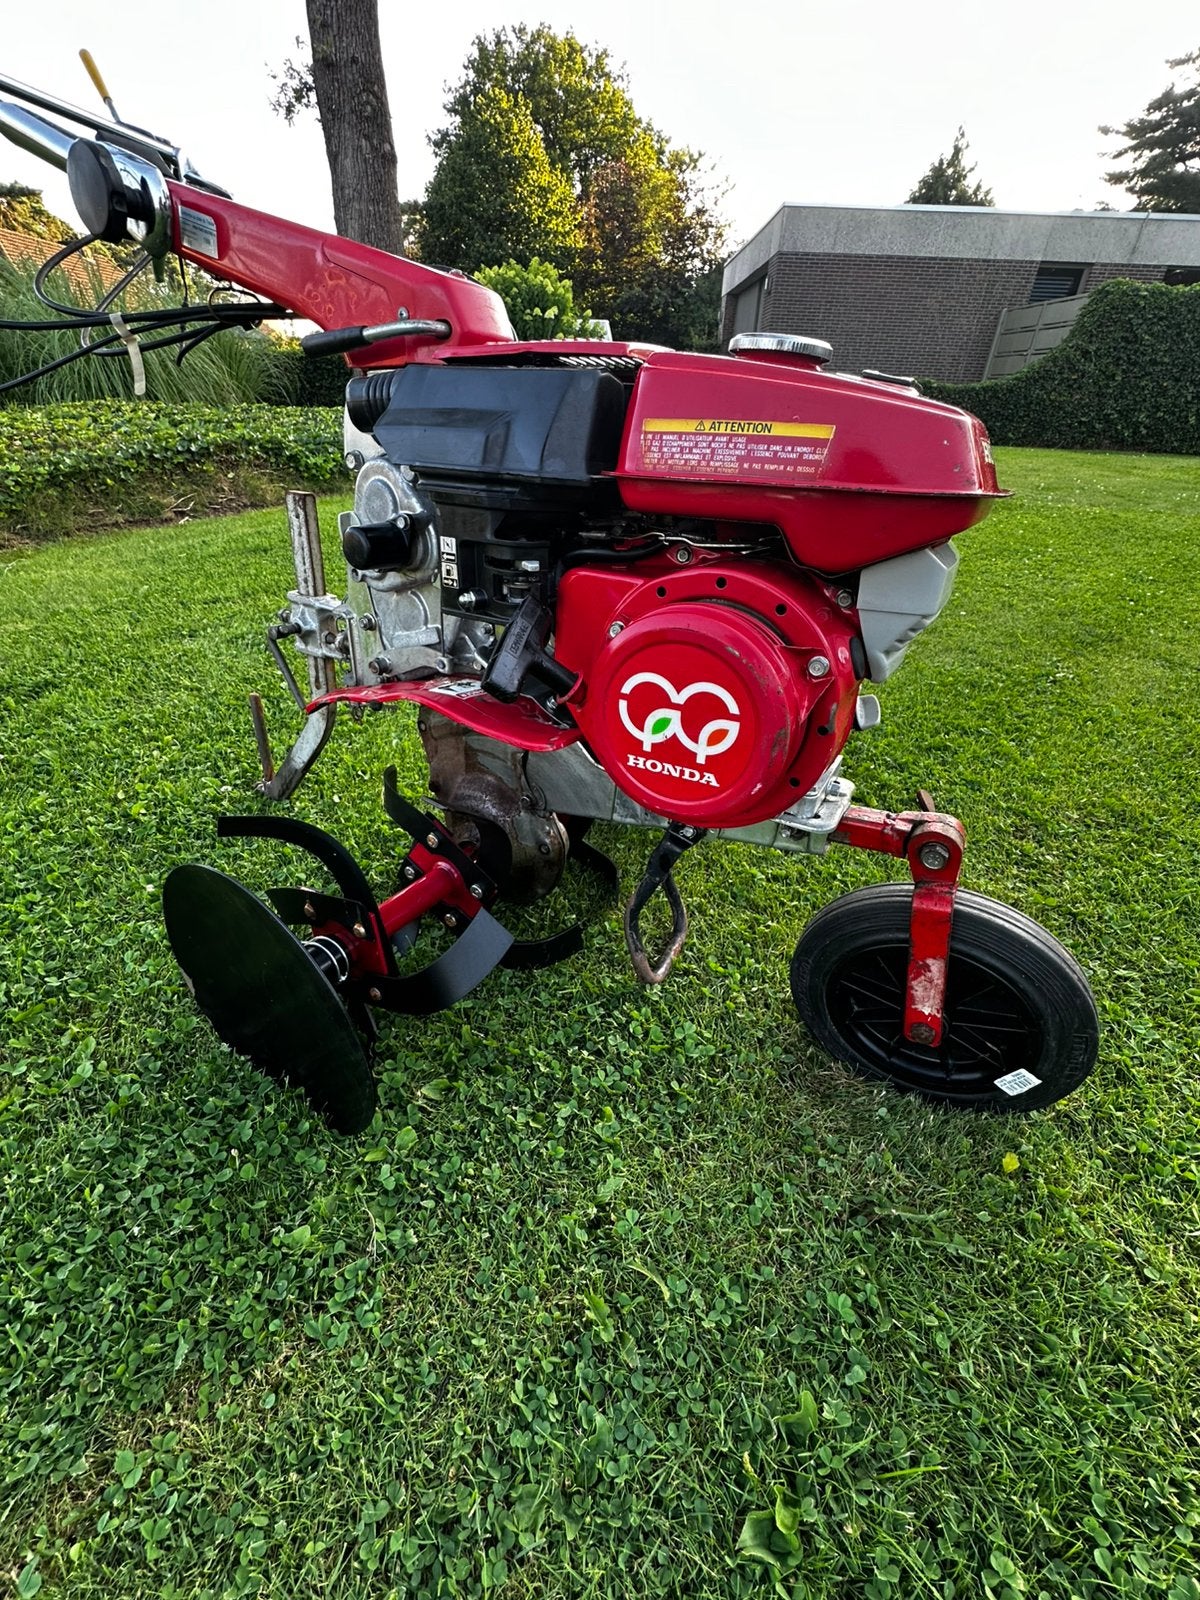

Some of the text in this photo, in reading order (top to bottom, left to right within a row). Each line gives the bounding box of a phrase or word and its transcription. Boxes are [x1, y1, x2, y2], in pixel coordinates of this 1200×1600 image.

[709, 421, 772, 433] ATTENTION
[764, 463, 784, 471] REMPLIR
[626, 753, 720, 788] HONDA
